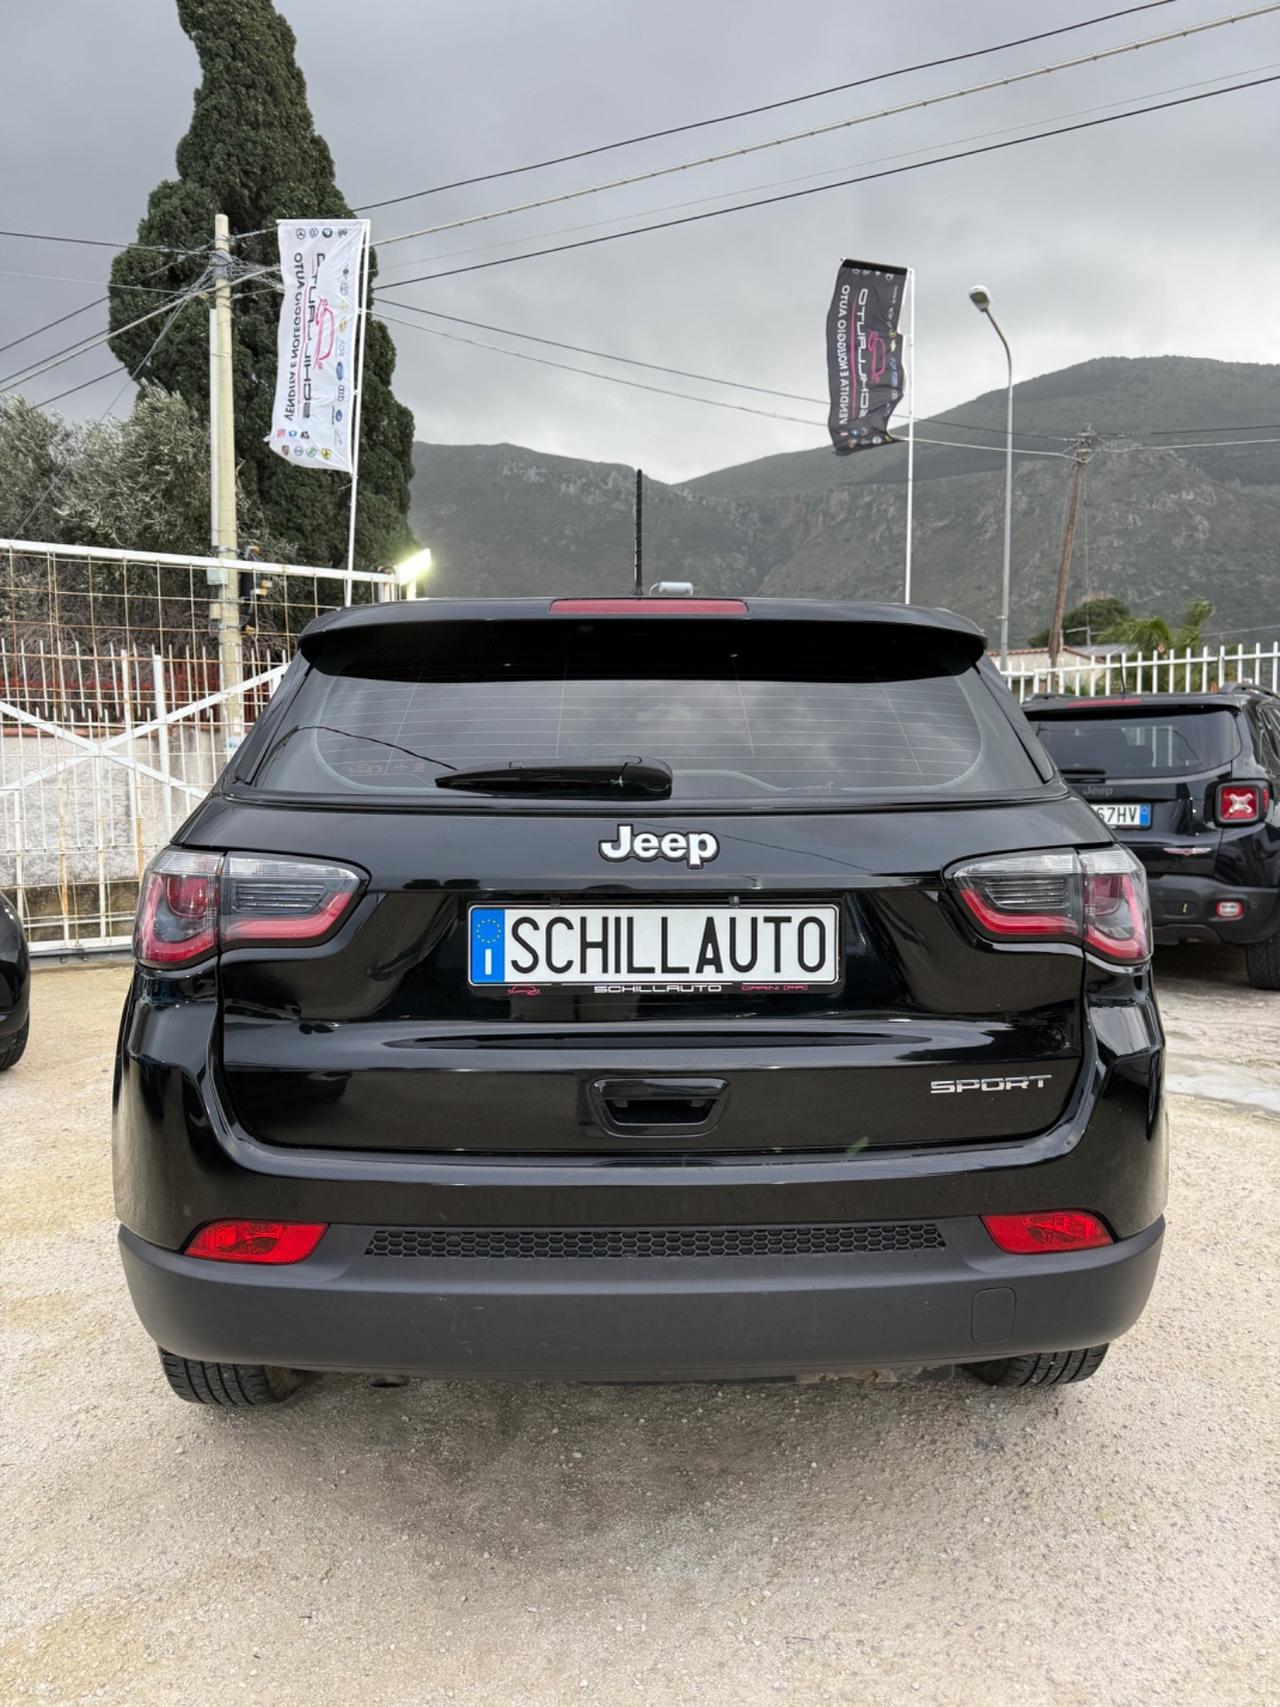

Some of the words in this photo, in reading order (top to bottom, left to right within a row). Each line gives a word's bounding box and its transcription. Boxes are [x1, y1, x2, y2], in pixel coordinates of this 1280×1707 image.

[599, 824, 720, 869] Jeep
[510, 916, 827, 974] SCHILLAUTO
[593, 984, 722, 993] SCHILLAUTO
[930, 1074, 1053, 1094] SPORT
